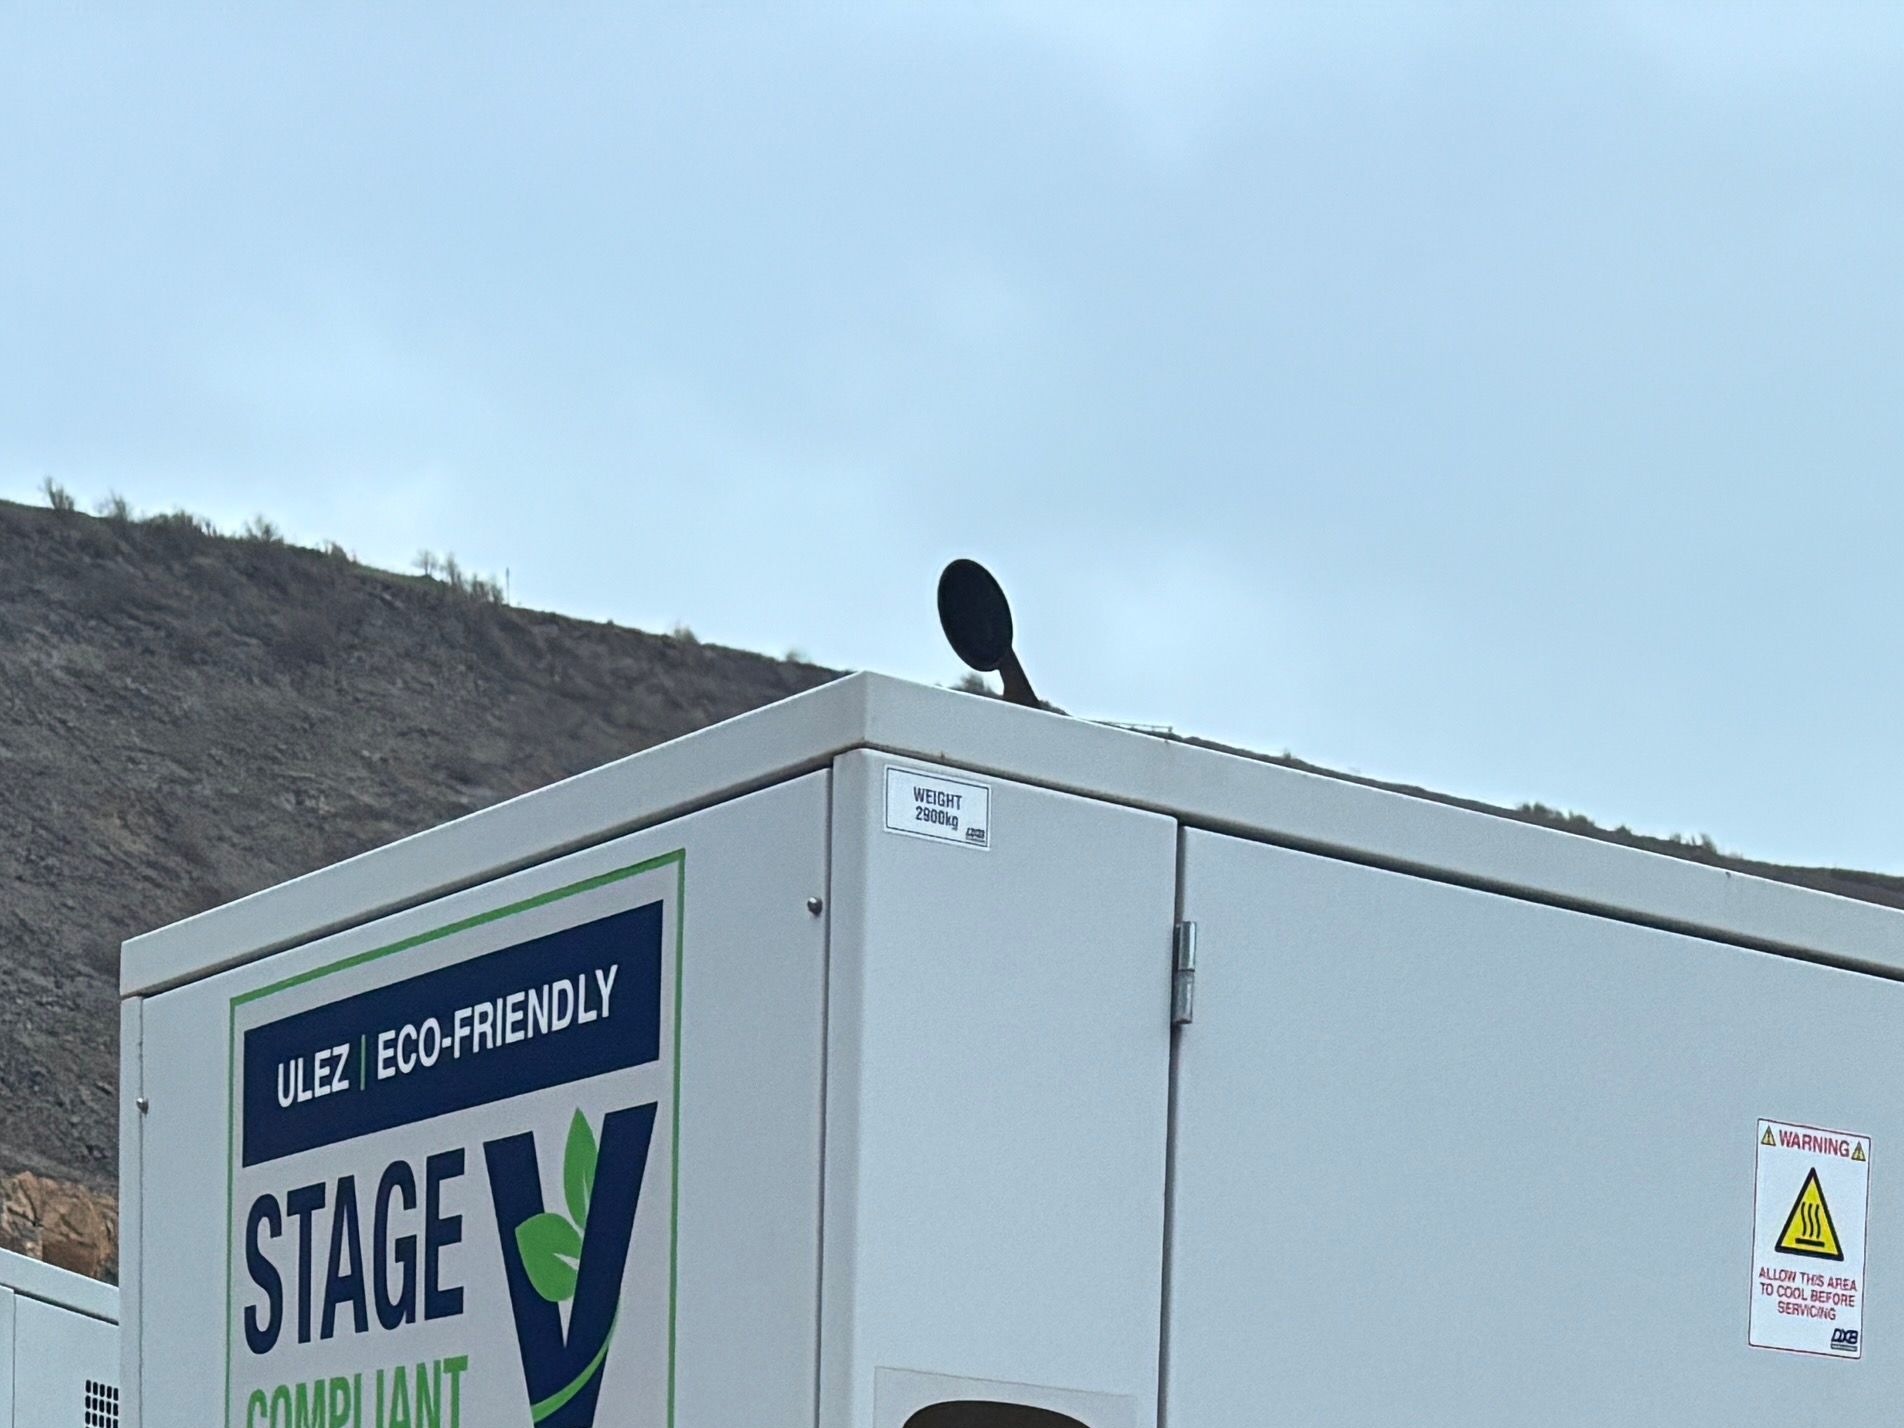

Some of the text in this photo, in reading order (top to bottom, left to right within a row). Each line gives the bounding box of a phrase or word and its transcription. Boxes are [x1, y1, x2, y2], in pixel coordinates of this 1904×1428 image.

[913, 786, 963, 810] WEIGHT
[277, 964, 618, 1107] ULEZ ECO-FRIENDLY
[1779, 1129, 1850, 1158] WARNING
[243, 1147, 466, 1355] STAGE
[1759, 1266, 1857, 1292] ALLOW THIS AREA
[1759, 1282, 1855, 1307] TO COOL BEFORE
[1777, 1301, 1837, 1321] SERVICING
